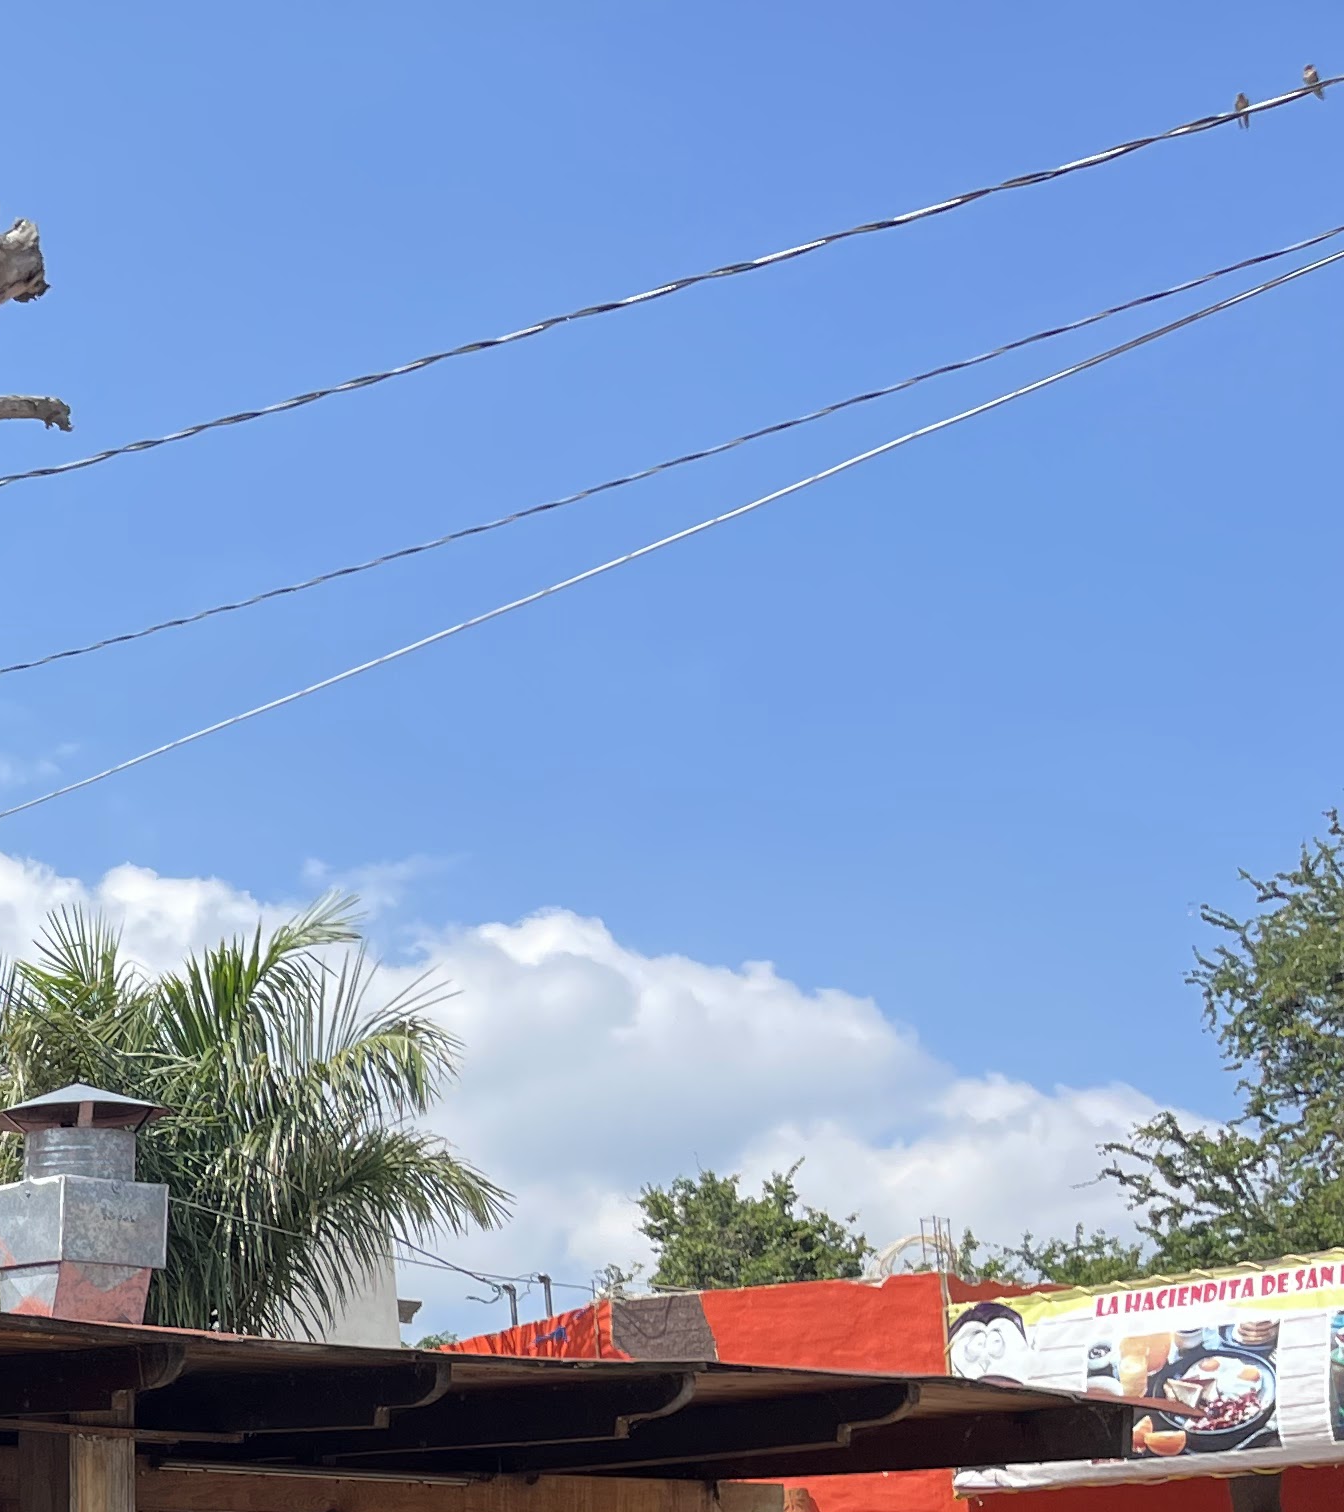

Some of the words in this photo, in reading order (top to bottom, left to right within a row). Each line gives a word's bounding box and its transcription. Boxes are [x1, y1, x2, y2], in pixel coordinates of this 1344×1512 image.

[1095, 1296, 1118, 1317] LA
[1124, 1277, 1254, 1313] HACIENDITA
[1261, 1272, 1288, 1296] DE
[1296, 1265, 1334, 1291] SAN
